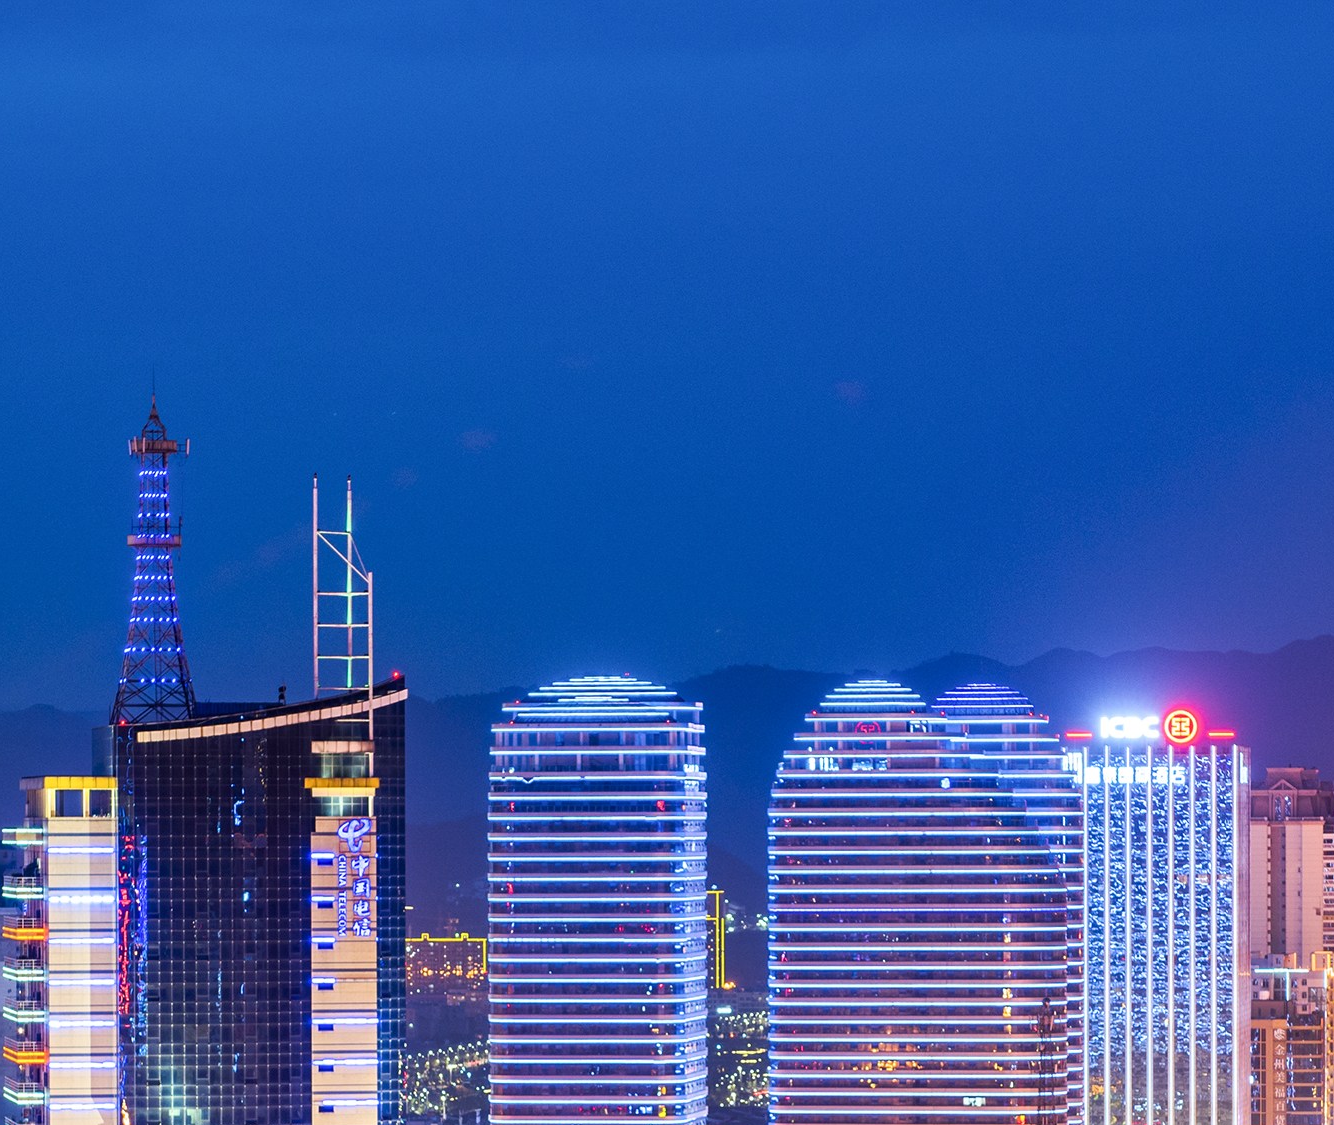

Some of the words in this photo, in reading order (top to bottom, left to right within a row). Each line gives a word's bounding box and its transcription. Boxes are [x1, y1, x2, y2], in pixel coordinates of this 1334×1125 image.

[1099, 716, 1159, 738] ICBC
[338, 854, 347, 887] CHINA
[338, 890, 347, 937] TELECOM
[351, 854, 371, 937] 中国电信
